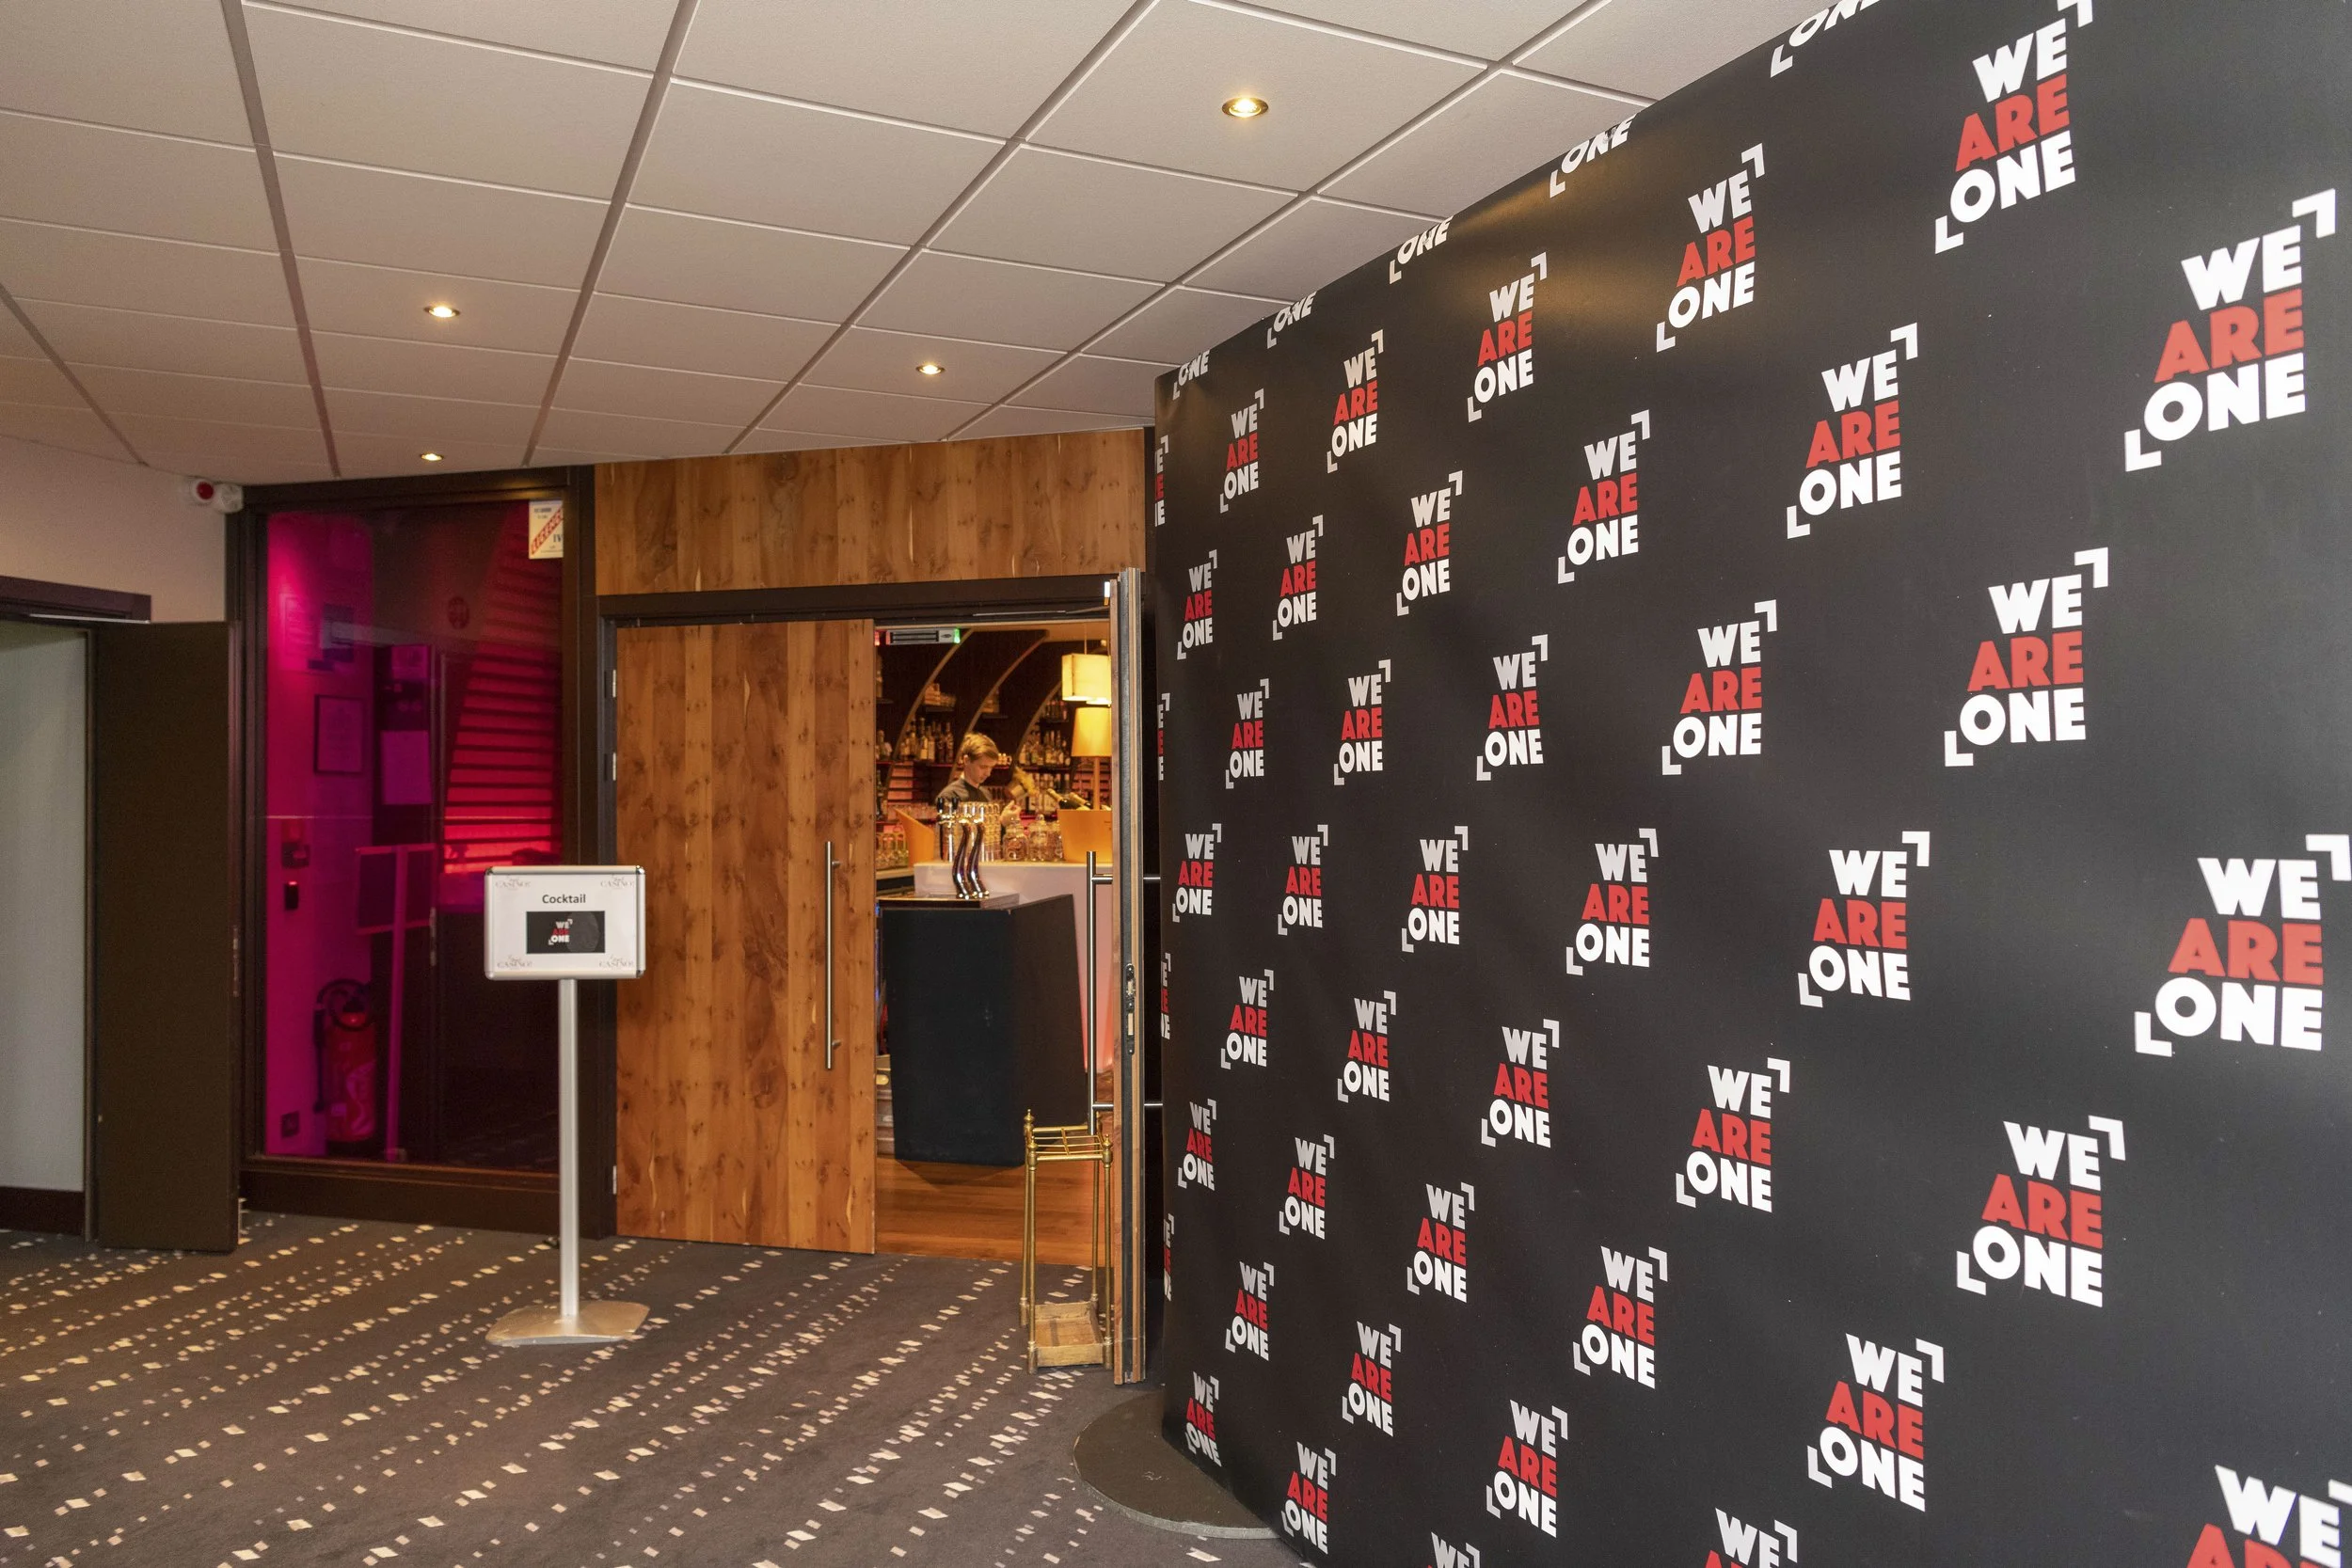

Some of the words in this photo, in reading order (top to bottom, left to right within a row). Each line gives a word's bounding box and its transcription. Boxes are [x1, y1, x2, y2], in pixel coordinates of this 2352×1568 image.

[1972, 18, 2067, 103] WE
[1562, 113, 1638, 173] ONE
[1956, 75, 2069, 171] ARE
[1950, 130, 2075, 223] ONE
[1688, 170, 1752, 233] WE
[1398, 215, 1454, 264] ONE
[1677, 216, 1756, 286] ARE
[2181, 224, 2303, 310] WE
[1274, 291, 1317, 332] ONE
[1489, 274, 1534, 322] WE
[1669, 261, 1755, 328] ONE
[1478, 310, 1533, 366] ARE
[2155, 289, 2303, 382] ARE
[1179, 349, 1210, 386] ONE
[1344, 347, 1376, 388] WE
[1474, 349, 1534, 403] ONE
[1821, 349, 1899, 412] WE
[1334, 380, 1377, 425] ARE
[2144, 352, 2306, 441] ONE
[1232, 404, 1257, 438] WE
[1332, 413, 1377, 456] ONE
[1806, 401, 1900, 468] ARE
[1227, 433, 1258, 469] ARE
[1584, 431, 1636, 480] WE
[1225, 462, 1258, 499] ONE
[1573, 473, 1638, 526] ARE
[1800, 451, 1901, 515] ONE
[1411, 488, 1451, 528] WE
[1287, 530, 1315, 563] WE
[1405, 523, 1450, 565] ARE
[1567, 515, 1638, 565] ONE
[1189, 563, 1211, 592] WE
[1280, 561, 1316, 596] ARE
[1403, 559, 1450, 600] ONE
[1185, 591, 1212, 621] ARE
[1278, 592, 1316, 626] ONE
[1988, 574, 2082, 634] WE
[1184, 618, 1213, 648] ONE
[1697, 621, 1761, 668] WE
[1493, 652, 1536, 689] WE
[1968, 631, 2083, 691] ARE
[1237, 691, 1263, 720] WE
[1348, 674, 1381, 706] WE
[1489, 690, 1539, 729] ARE
[1680, 667, 1762, 714] ARE
[1232, 721, 1263, 749] ARE
[1342, 707, 1382, 740] ARE
[1673, 713, 1761, 758] ONE
[1960, 688, 2086, 745] ONE
[1230, 750, 1263, 778] ONE
[1340, 740, 1383, 772] ONE
[1486, 729, 1543, 767] ONE
[1185, 834, 1214, 859] WE
[1292, 836, 1320, 864] WE
[1420, 840, 1458, 872] WE
[1595, 844, 1647, 882] WE
[1179, 862, 1213, 887] ARE
[1286, 866, 1321, 896] ARE
[1411, 874, 1459, 909] ARE
[1829, 850, 1907, 897] WE
[2197, 858, 2321, 920] WE
[542, 894, 586, 904] Cocktail
[1176, 887, 1212, 915] ONE
[1283, 896, 1322, 927] ONE
[1582, 883, 1649, 925] ARE
[1408, 908, 1459, 944] ONE
[1576, 924, 1649, 967] ONE
[1814, 898, 1907, 949] ARE
[1809, 945, 1911, 1001] ONE
[2169, 918, 2323, 985] ARE
[1239, 976, 1266, 1007] WE
[1230, 1005, 1266, 1037] ARE
[1355, 998, 1387, 1034] WE
[2155, 977, 2323, 1052] ONE
[1227, 1033, 1266, 1067] ONE
[1348, 1030, 1388, 1068] ARE
[1502, 1027, 1547, 1069] WE
[1343, 1061, 1389, 1101] ONE
[1494, 1063, 1549, 1109] ARE
[1708, 1065, 1772, 1118] WE
[1190, 1102, 1211, 1134] WE
[1490, 1100, 1550, 1148] ONE
[1692, 1109, 1771, 1165] ARE
[1186, 1129, 1212, 1162] ARE
[1295, 1137, 1326, 1176] WE
[2003, 1121, 2101, 1191] WE
[1184, 1154, 1215, 1190] ONE
[1288, 1167, 1326, 1207] ARE
[1687, 1151, 1772, 1212] ONE
[1285, 1196, 1325, 1239] ONE
[1426, 1184, 1465, 1229] WE
[1982, 1174, 2103, 1248] ARE
[1417, 1218, 1466, 1265] ARE
[1240, 1261, 1266, 1301] WE
[1414, 1251, 1467, 1303] ONE
[1601, 1246, 1653, 1303] WE
[1973, 1226, 2103, 1307] ONE
[1235, 1290, 1267, 1330] ARE
[1587, 1286, 1655, 1346] ARE
[1232, 1316, 1268, 1360] ONE
[1357, 1322, 1391, 1369] WE
[1582, 1324, 1655, 1388] ONE
[1194, 1372, 1213, 1412] WE
[1352, 1354, 1391, 1402] ARE
[1846, 1333, 1923, 1407] WE
[1187, 1399, 1215, 1439] ARE
[1349, 1383, 1392, 1436] ONE
[1510, 1400, 1556, 1458] WE
[1826, 1382, 1923, 1460] ARE
[1186, 1423, 1221, 1466] ONE
[1297, 1442, 1327, 1490] WE
[1498, 1436, 1557, 1497] ARE
[1820, 1427, 1925, 1512] ONE
[1287, 1472, 1327, 1521] ARE
[1494, 1471, 1556, 1538] ONE
[2215, 1465, 2342, 1568] WE
[1285, 1499, 1327, 1555] ONE
[1715, 1507, 1779, 1568] WE
